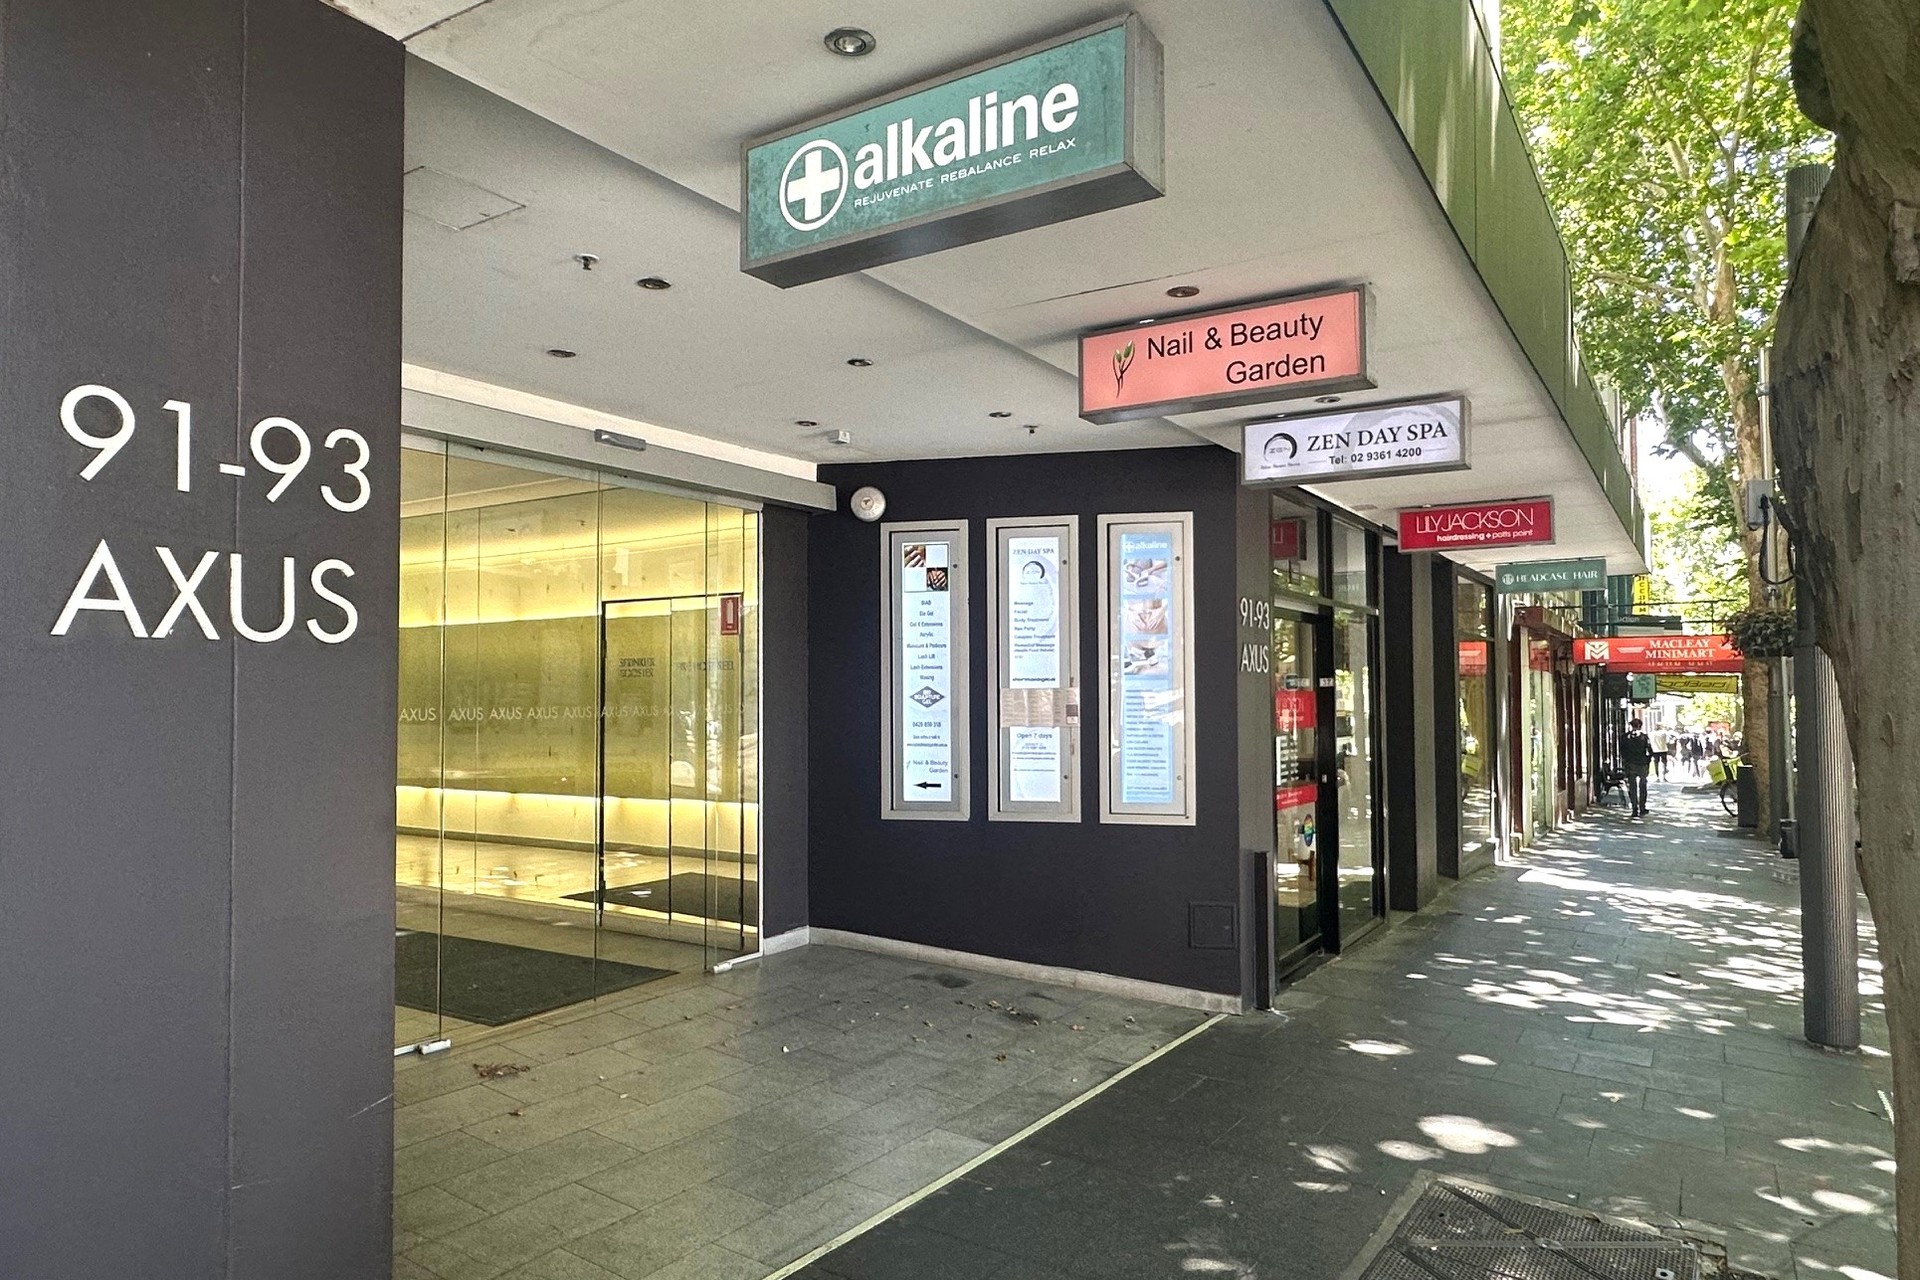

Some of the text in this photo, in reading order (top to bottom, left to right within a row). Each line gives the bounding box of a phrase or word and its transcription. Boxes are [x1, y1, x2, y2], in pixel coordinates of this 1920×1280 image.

[853, 83, 1080, 190] alkaline
[854, 137, 1077, 208] REJUVENATE REBALANCE RELAX
[1147, 313, 1324, 360] Nail & Beauty
[1226, 354, 1325, 384] Garden
[60, 384, 371, 513] 91-93
[1307, 421, 1448, 452] ZEN DAY SPA
[1328, 447, 1422, 465] Tel: 02 9361 4200
[1436, 529, 1533, 542] hairdressing potts point
[50, 538, 358, 644] AXUS
[1516, 570, 1598, 583] HEADCASE HAIR
[1240, 597, 1270, 630] 91-93
[1240, 644, 1269, 673] AXUS
[1645, 649, 1716, 659] MINIMART
[1650, 639, 1711, 649] MACLEAY
[399, 707, 437, 722] AXUS
[448, 707, 485, 721] AXUS
[489, 707, 522, 720] AXUS
[527, 706, 558, 720] AXUS
[563, 706, 592, 719] AXUS
[600, 706, 629, 718] AXUS
